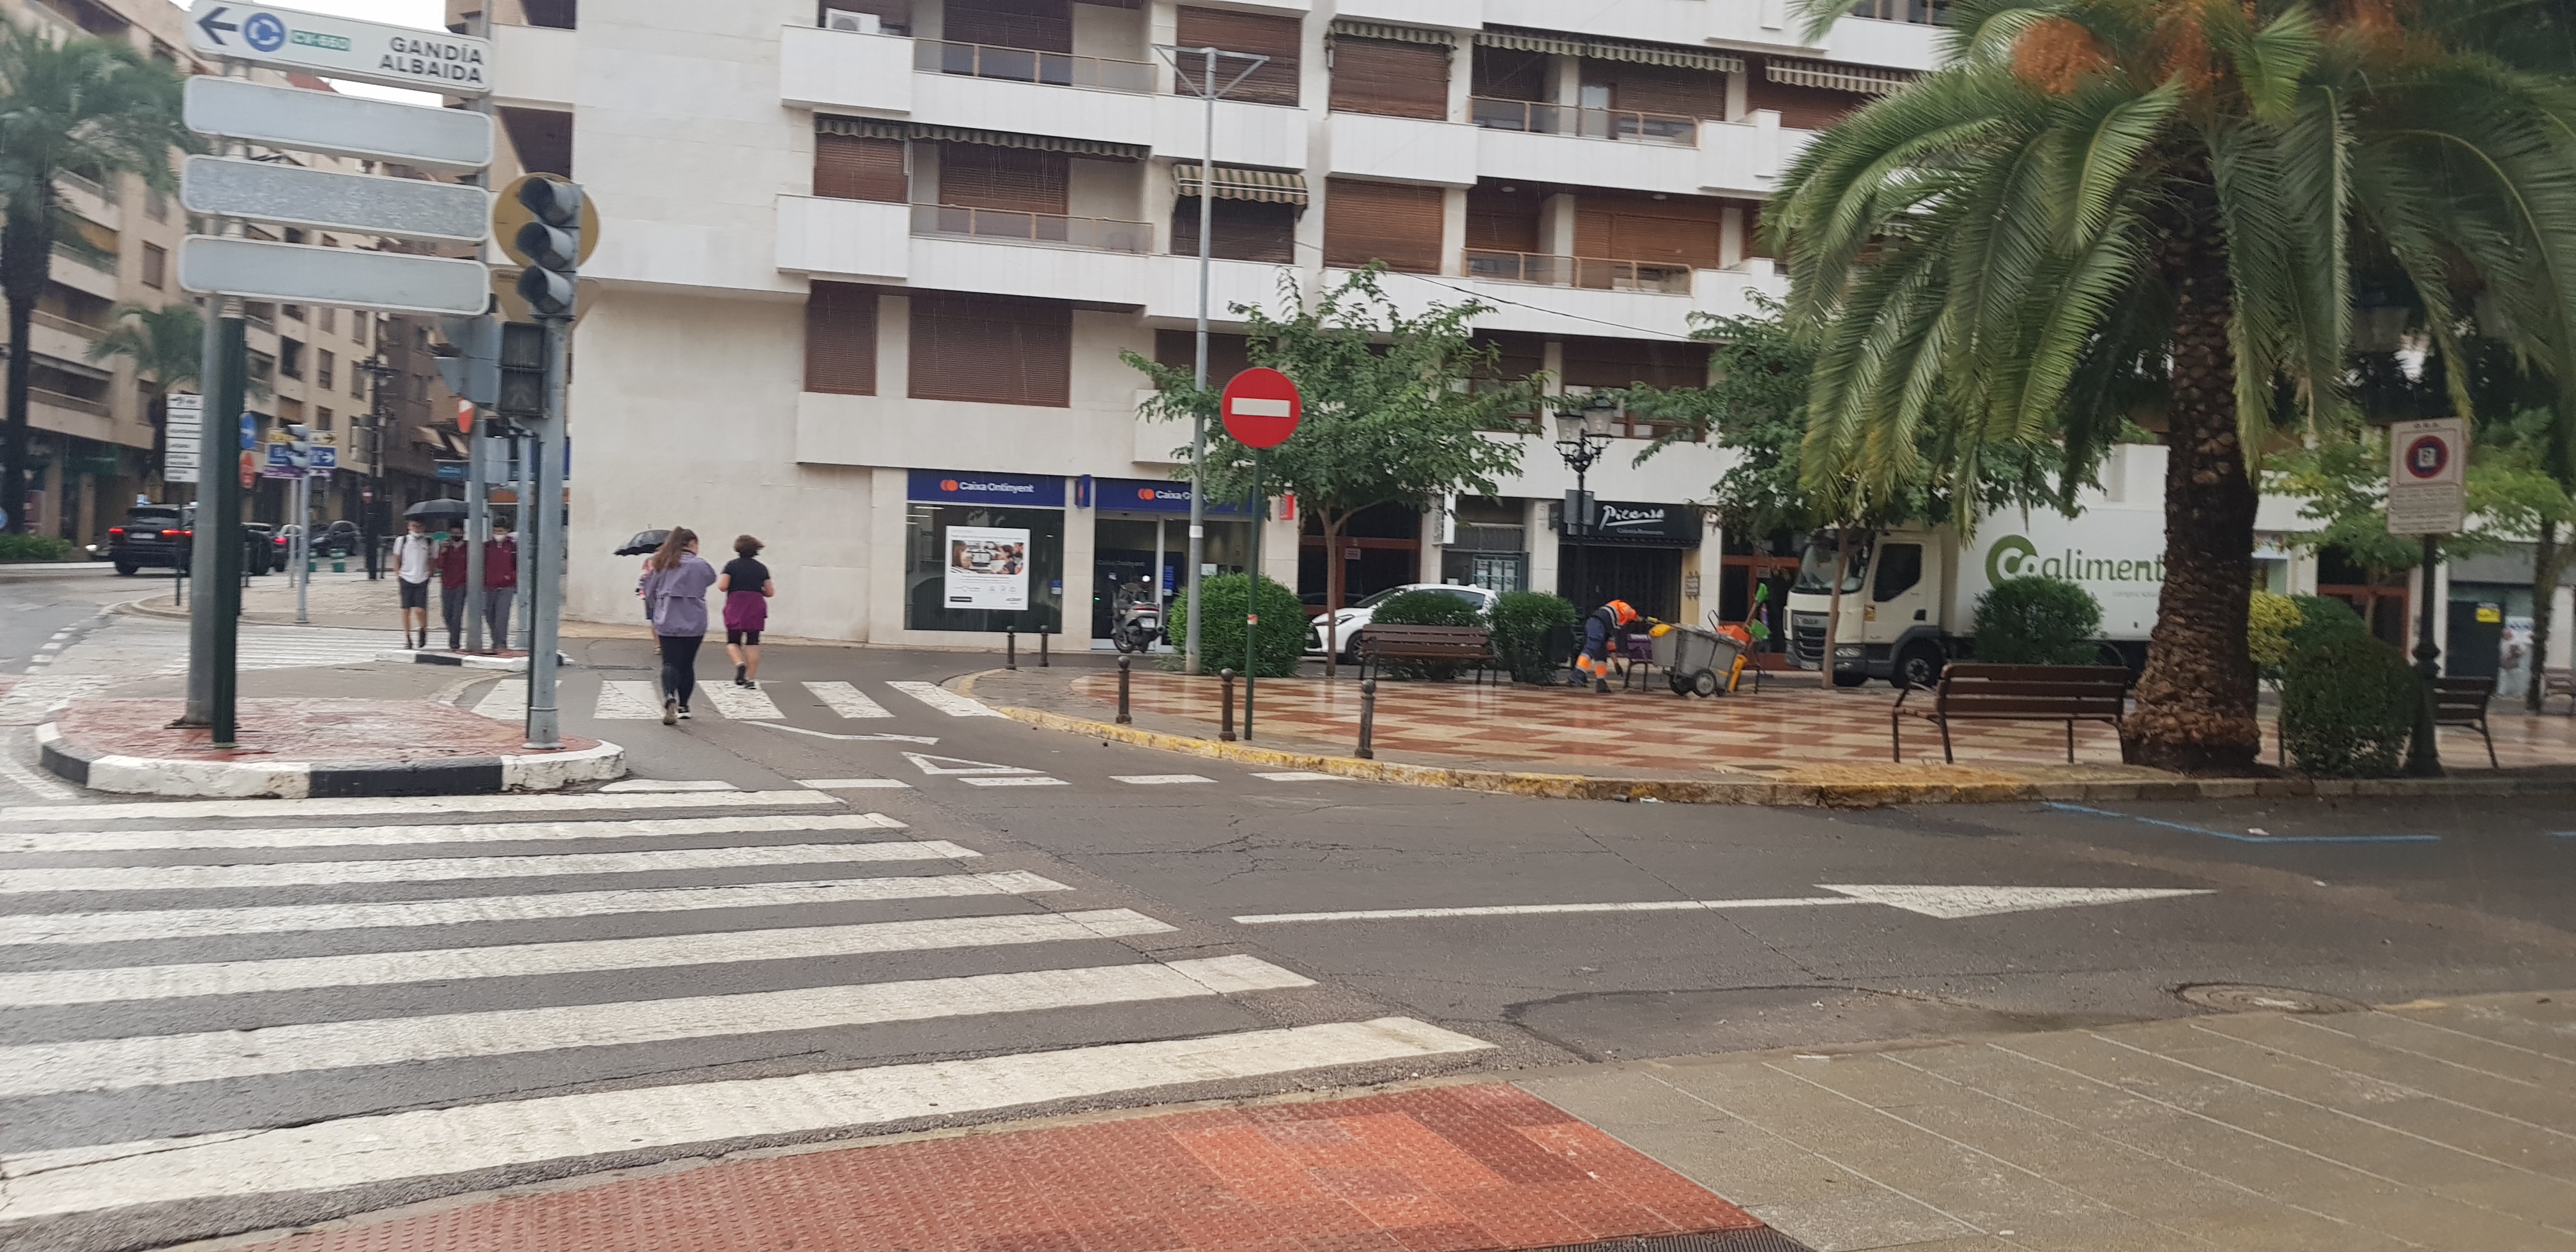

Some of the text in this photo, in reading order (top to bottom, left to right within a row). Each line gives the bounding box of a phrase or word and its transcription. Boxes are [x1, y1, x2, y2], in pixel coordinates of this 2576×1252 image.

[390, 36, 484, 65] GANDÍA
[379, 54, 484, 84] ALBAIDA
[959, 482, 1034, 494] Caixa Ontinyent
[1155, 490, 1182, 500] Caixa
